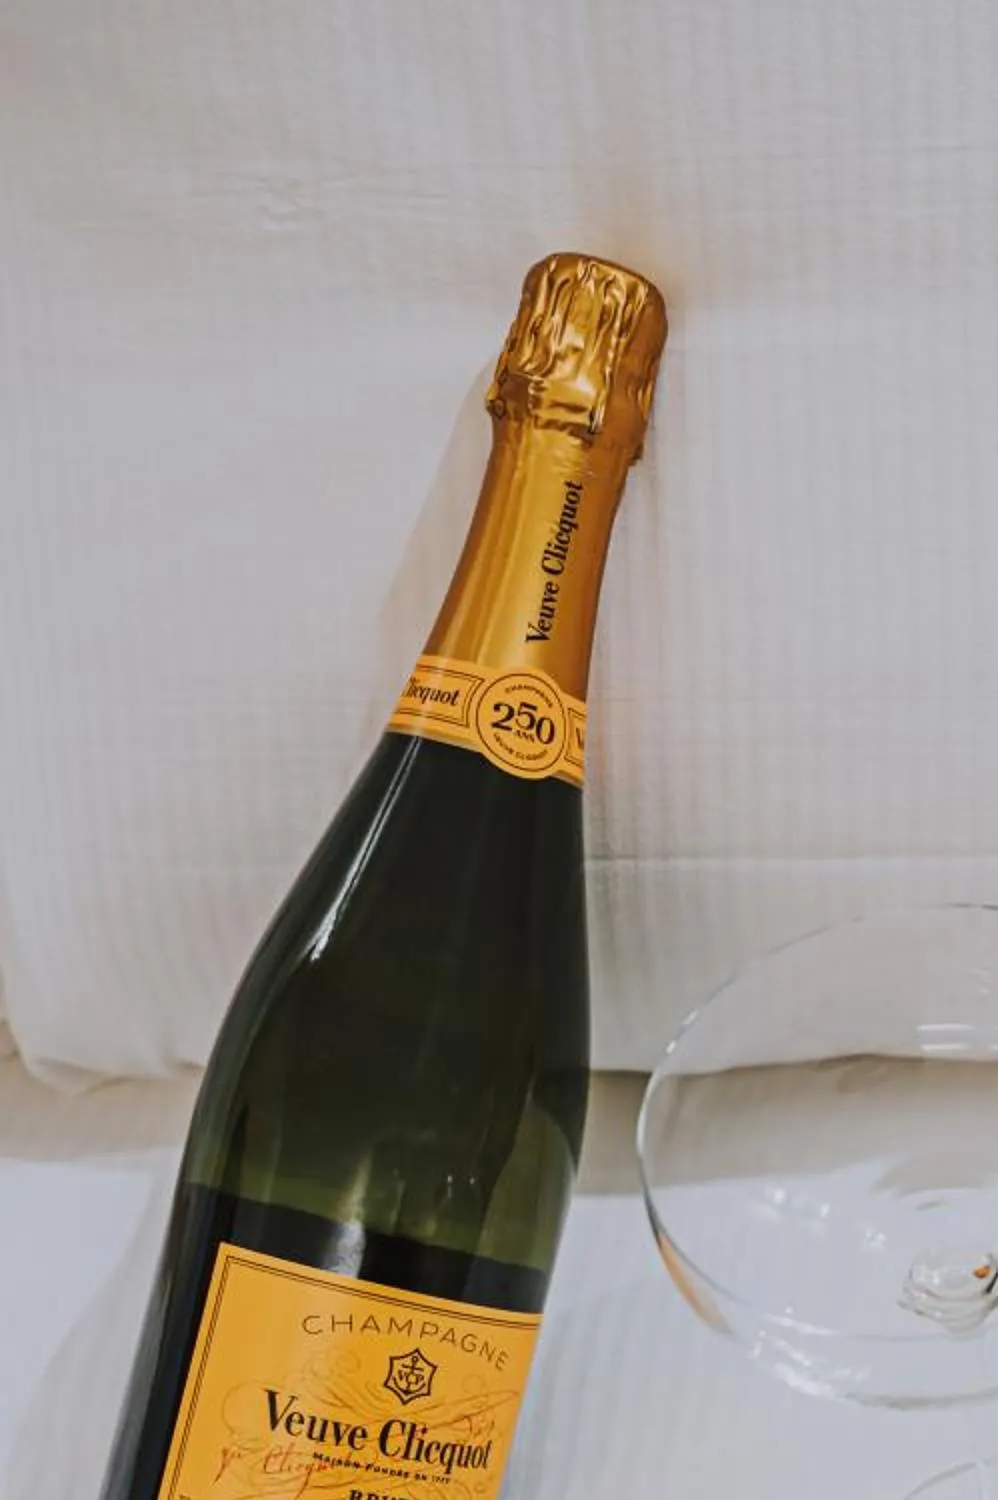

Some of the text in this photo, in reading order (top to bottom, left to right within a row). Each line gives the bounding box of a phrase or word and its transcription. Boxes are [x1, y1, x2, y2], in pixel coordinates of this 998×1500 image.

[525, 480, 584, 643] Veuve Clicquot
[402, 676, 460, 707] licquot
[490, 701, 556, 745] 250
[302, 1314, 509, 1372] CHAMPAGNE
[264, 1388, 493, 1475] Veuve Clicquot
